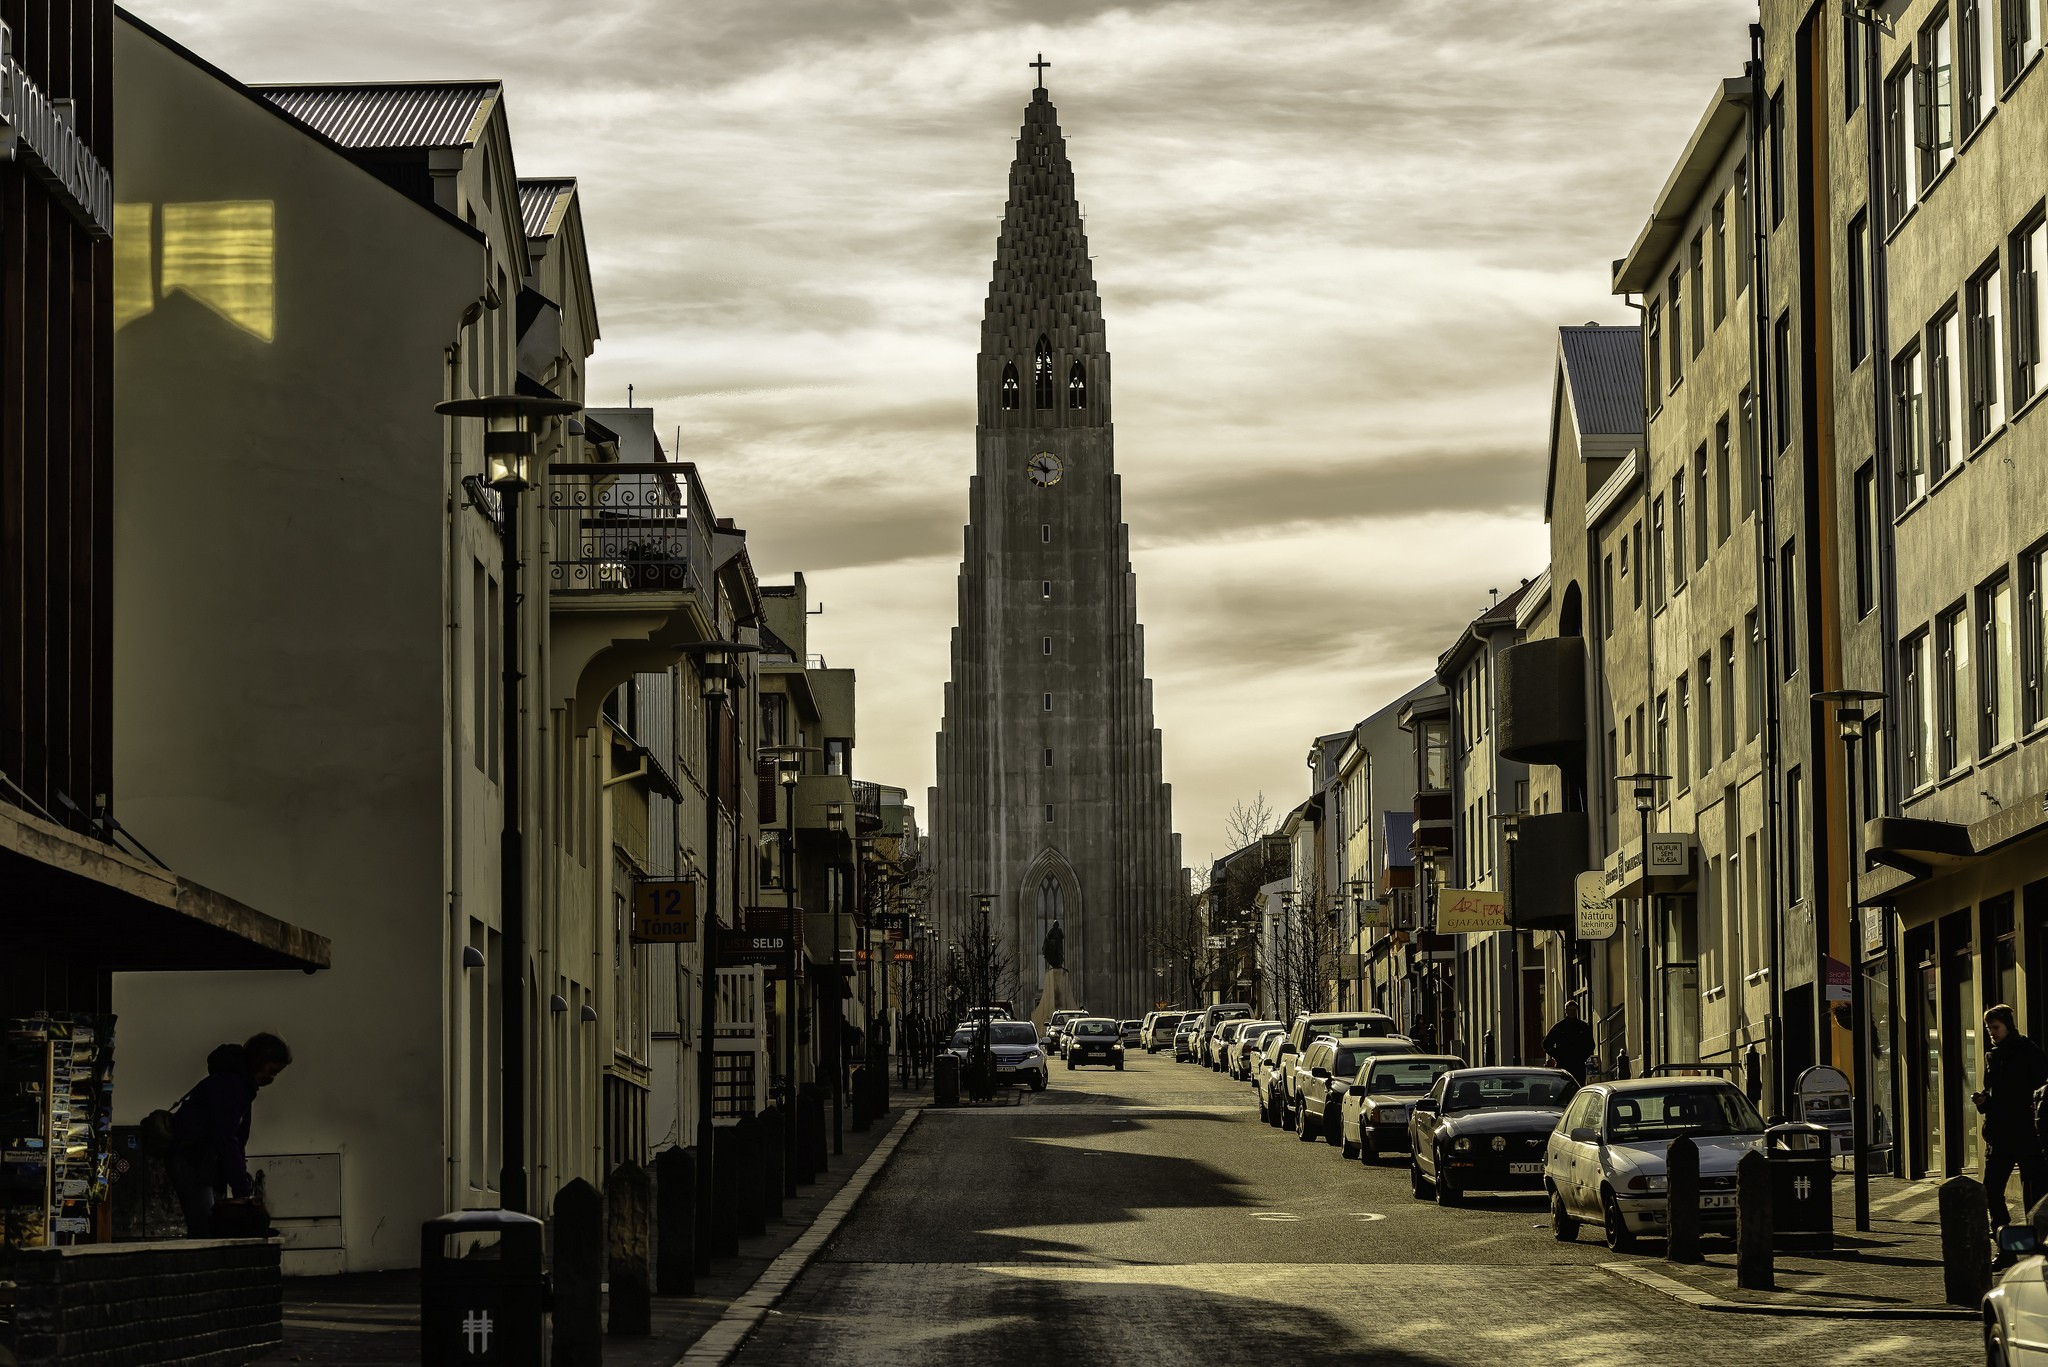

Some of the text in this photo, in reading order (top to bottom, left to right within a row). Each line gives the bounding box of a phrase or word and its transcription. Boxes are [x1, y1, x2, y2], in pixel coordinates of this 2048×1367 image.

[0, 17, 112, 239] Eymundsson
[649, 889, 681, 915] 12
[1581, 910, 1613, 921] Náttúru
[641, 918, 689, 935] Tónar
[1581, 920, 1613, 930] lækninga
[1581, 928, 1601, 936] búðin
[1517, 1164, 1532, 1172] YU
